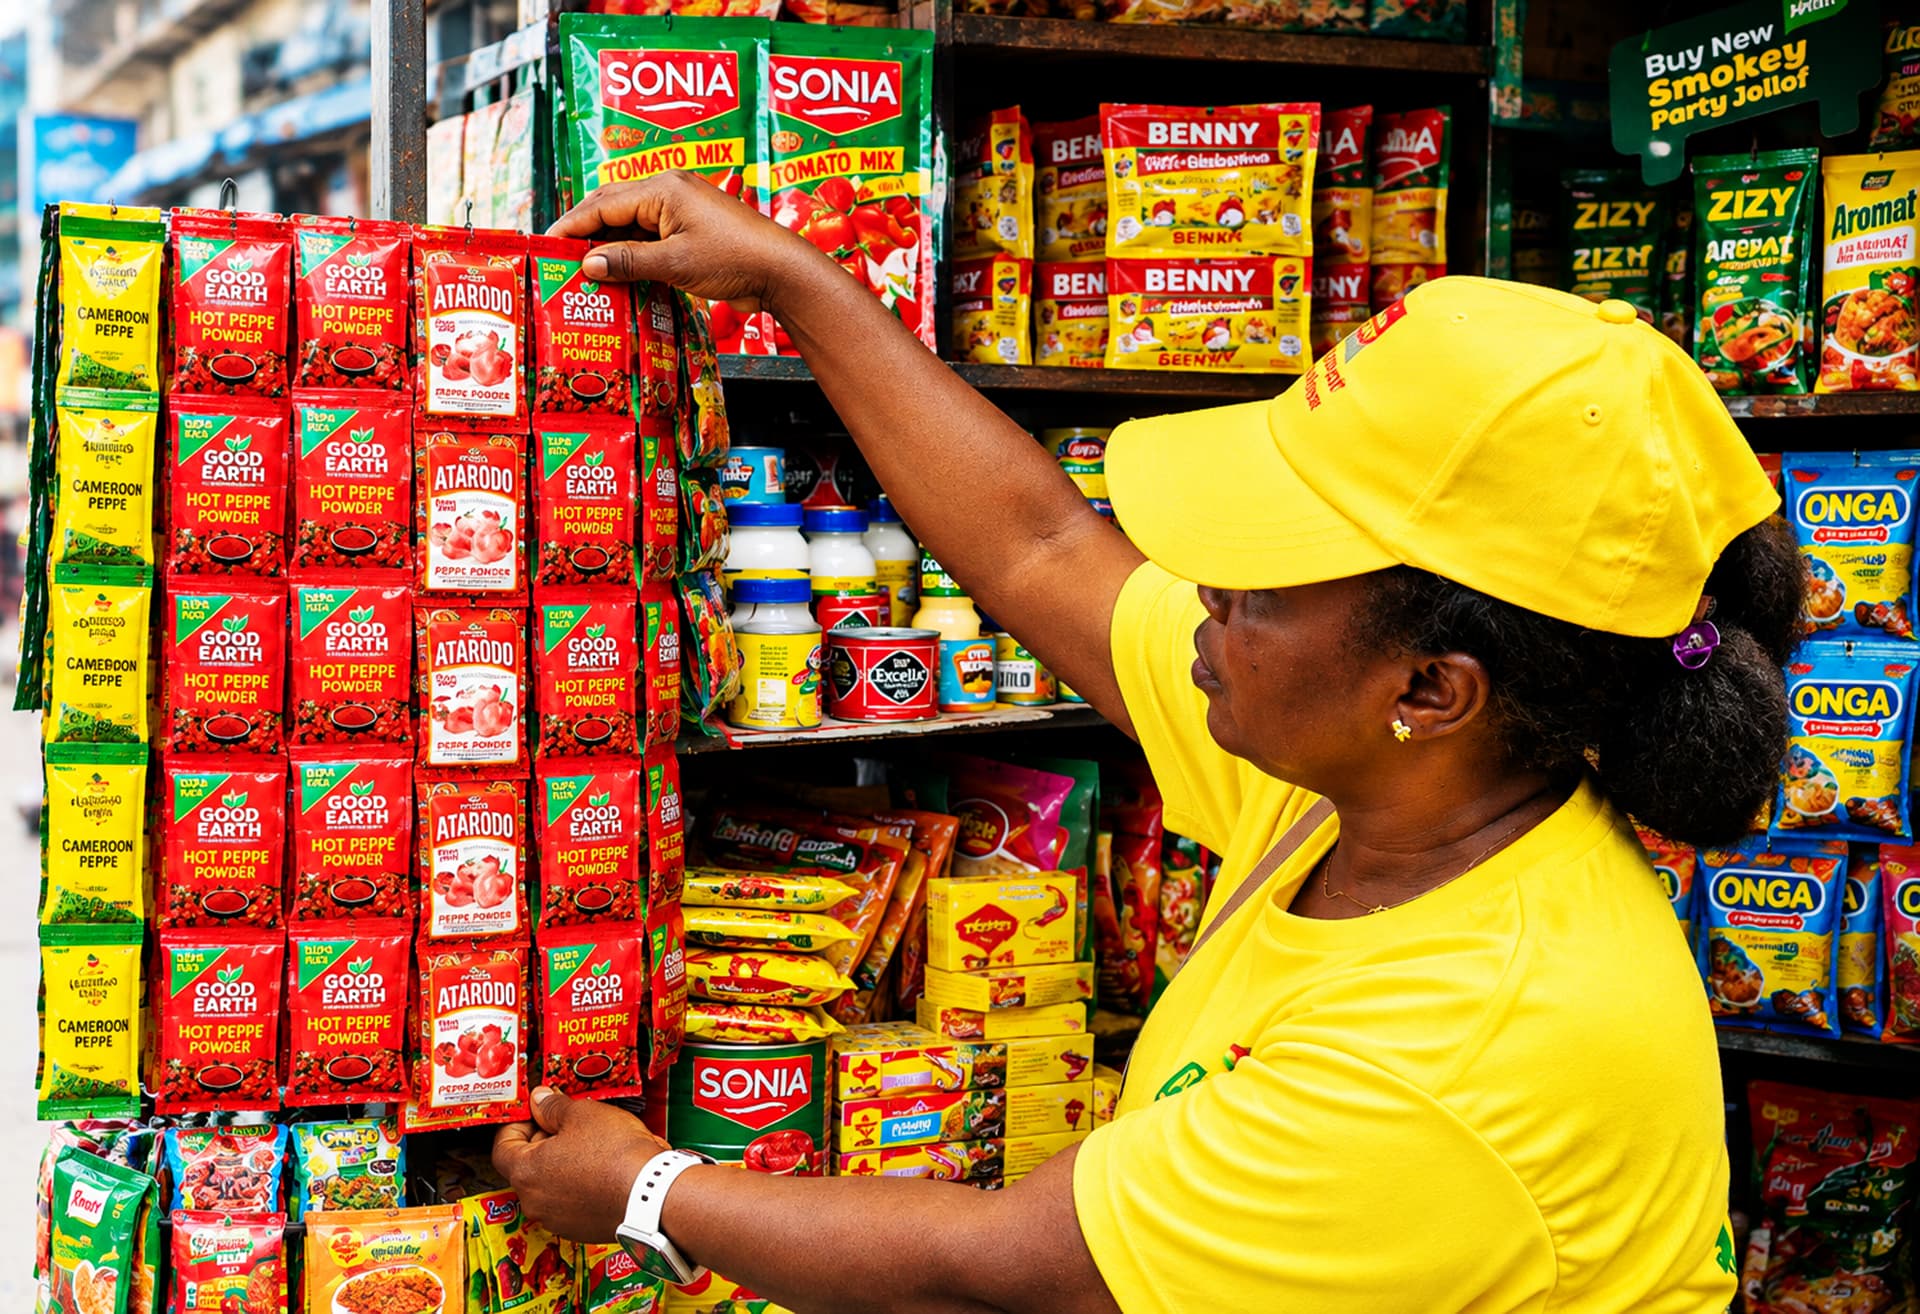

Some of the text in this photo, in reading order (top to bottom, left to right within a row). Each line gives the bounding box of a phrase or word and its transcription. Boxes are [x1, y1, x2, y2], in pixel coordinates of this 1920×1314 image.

[1644, 24, 1774, 79] Buy New
[606, 61, 735, 98] SONIA
[1648, 40, 1807, 107] Smokey
[774, 65, 897, 105] SONIA
[1651, 65, 1810, 131] Party Jollof
[1148, 121, 1260, 145] BENNY
[604, 143, 733, 184] TOMATO MIX
[771, 149, 895, 185] TOMATO MIX
[1706, 186, 1796, 222] ZIZY
[1573, 201, 1657, 230] ZIZY
[1831, 189, 1917, 240] Aromat
[205, 268, 266, 287] GOOD
[325, 264, 385, 280] GOOD
[1145, 269, 1255, 292] BENNY
[205, 283, 268, 302] EARTH
[325, 279, 387, 296] EARTH
[433, 283, 513, 316] ATARODO
[562, 292, 611, 309] GOOD
[77, 307, 149, 325] CAMEROON
[190, 311, 275, 330] HOT PEPPE
[311, 304, 394, 323] HOT PEPPE
[563, 306, 615, 323] EARTH
[95, 323, 134, 339] PEPPE
[201, 327, 263, 344] POWDER
[323, 320, 382, 337] POWDER
[551, 331, 622, 350] HOT PEPPE
[562, 347, 613, 363] POWDER
[203, 448, 263, 467] GOOD
[326, 441, 386, 459] GOOD
[325, 456, 389, 473] EARTH
[566, 464, 615, 481] GOOD
[201, 465, 265, 483] EARTH
[434, 464, 513, 493] ATARODO
[72, 480, 142, 497] CAMEROON
[310, 485, 395, 501] HOT PEPPE
[565, 479, 618, 496] EARTH
[88, 497, 127, 511] PEPPE
[185, 493, 271, 510] HOT PEPPE
[321, 500, 383, 514] POWDER
[1804, 493, 1899, 523] ONGA
[198, 509, 260, 524] POWDER
[553, 506, 624, 522] HOT PEPPE
[563, 521, 614, 536] POWDER
[326, 622, 386, 637] GOOD
[201, 631, 260, 646] GOOD
[325, 636, 389, 651] EARTH
[568, 637, 617, 653] GOOD
[198, 646, 262, 662] EARTH
[435, 639, 514, 667] ATARODO
[567, 651, 620, 667] EARTH
[309, 664, 396, 678] HOT PEPPE
[83, 673, 122, 687] PEPPE
[184, 673, 270, 689] HOT PEPPE
[321, 681, 383, 693] POWDER
[555, 678, 625, 694] HOT PEPPE
[195, 689, 258, 704] POWDER
[565, 693, 616, 707] POWDER
[1794, 686, 1891, 716] ONGA
[328, 795, 387, 810] GOOD
[199, 807, 260, 822] GOOD
[325, 809, 389, 824] EARTH
[571, 806, 620, 821] GOOD
[197, 822, 262, 837] EARTH
[436, 812, 514, 842] ATARODO
[570, 820, 622, 837] EARTH
[62, 839, 134, 854] CAMEROON
[311, 837, 396, 852] HOT PEPPE
[79, 855, 118, 869] PEPPE
[183, 850, 269, 865] HOT PEPPE
[322, 853, 384, 867] POWDER
[556, 845, 629, 864] HOT PEPPE
[194, 865, 256, 879] POWDER
[567, 861, 619, 878] POWDER
[1718, 876, 1814, 910] ONGA
[195, 981, 255, 997] GOOD
[323, 973, 384, 989] GOOD
[571, 975, 622, 992] GOOD
[321, 988, 386, 1004] EARTH
[437, 981, 516, 1014] ATARODO
[571, 988, 624, 1007] EARTH
[193, 996, 257, 1014] EARTH
[58, 1019, 129, 1034] CAMEROON
[178, 1024, 264, 1039] HOT PEPPE
[306, 1015, 391, 1031] HOT PEPPE
[558, 1013, 630, 1034] HOT PEPPE
[75, 1035, 113, 1048] PEPPE
[317, 1031, 379, 1045] POWDER
[567, 1029, 619, 1046] POWDER
[189, 1039, 251, 1054] POWDER
[699, 1067, 808, 1098] SONIA
